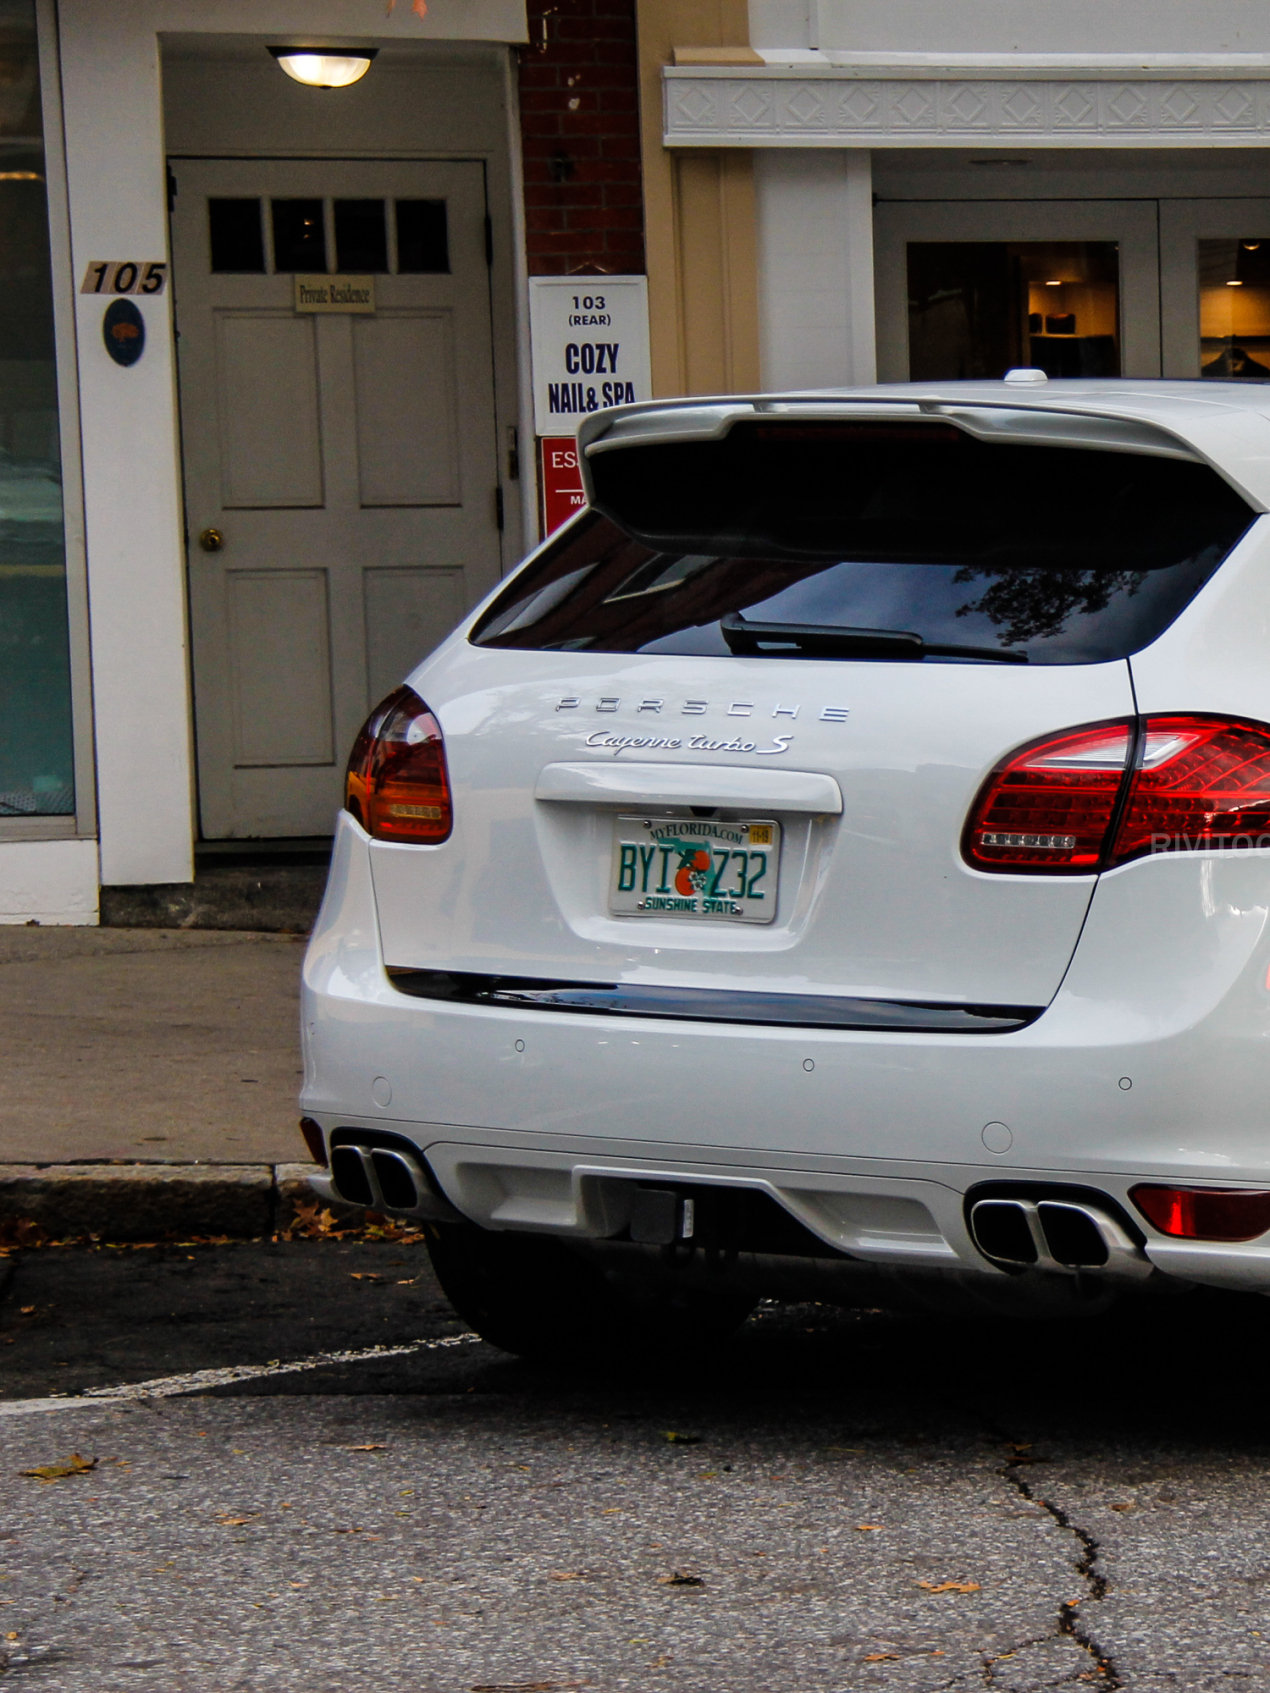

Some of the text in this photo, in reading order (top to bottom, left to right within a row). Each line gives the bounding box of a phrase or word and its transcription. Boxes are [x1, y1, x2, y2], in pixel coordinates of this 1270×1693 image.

[94, 262, 167, 293] 105
[300, 284, 370, 304] Private Residence
[573, 296, 606, 310] 103
[568, 314, 611, 327] (REAR)
[565, 343, 619, 374] COZY
[602, 382, 635, 408] SPA
[552, 452, 580, 468] ES
[556, 697, 850, 722] PORSCHE
[585, 731, 682, 755] Cayenne
[756, 735, 794, 754] S
[650, 822, 744, 845] MYFLORIDA.COM
[710, 850, 767, 899] Z32
[645, 896, 737, 914] SUNSHINE STATE
